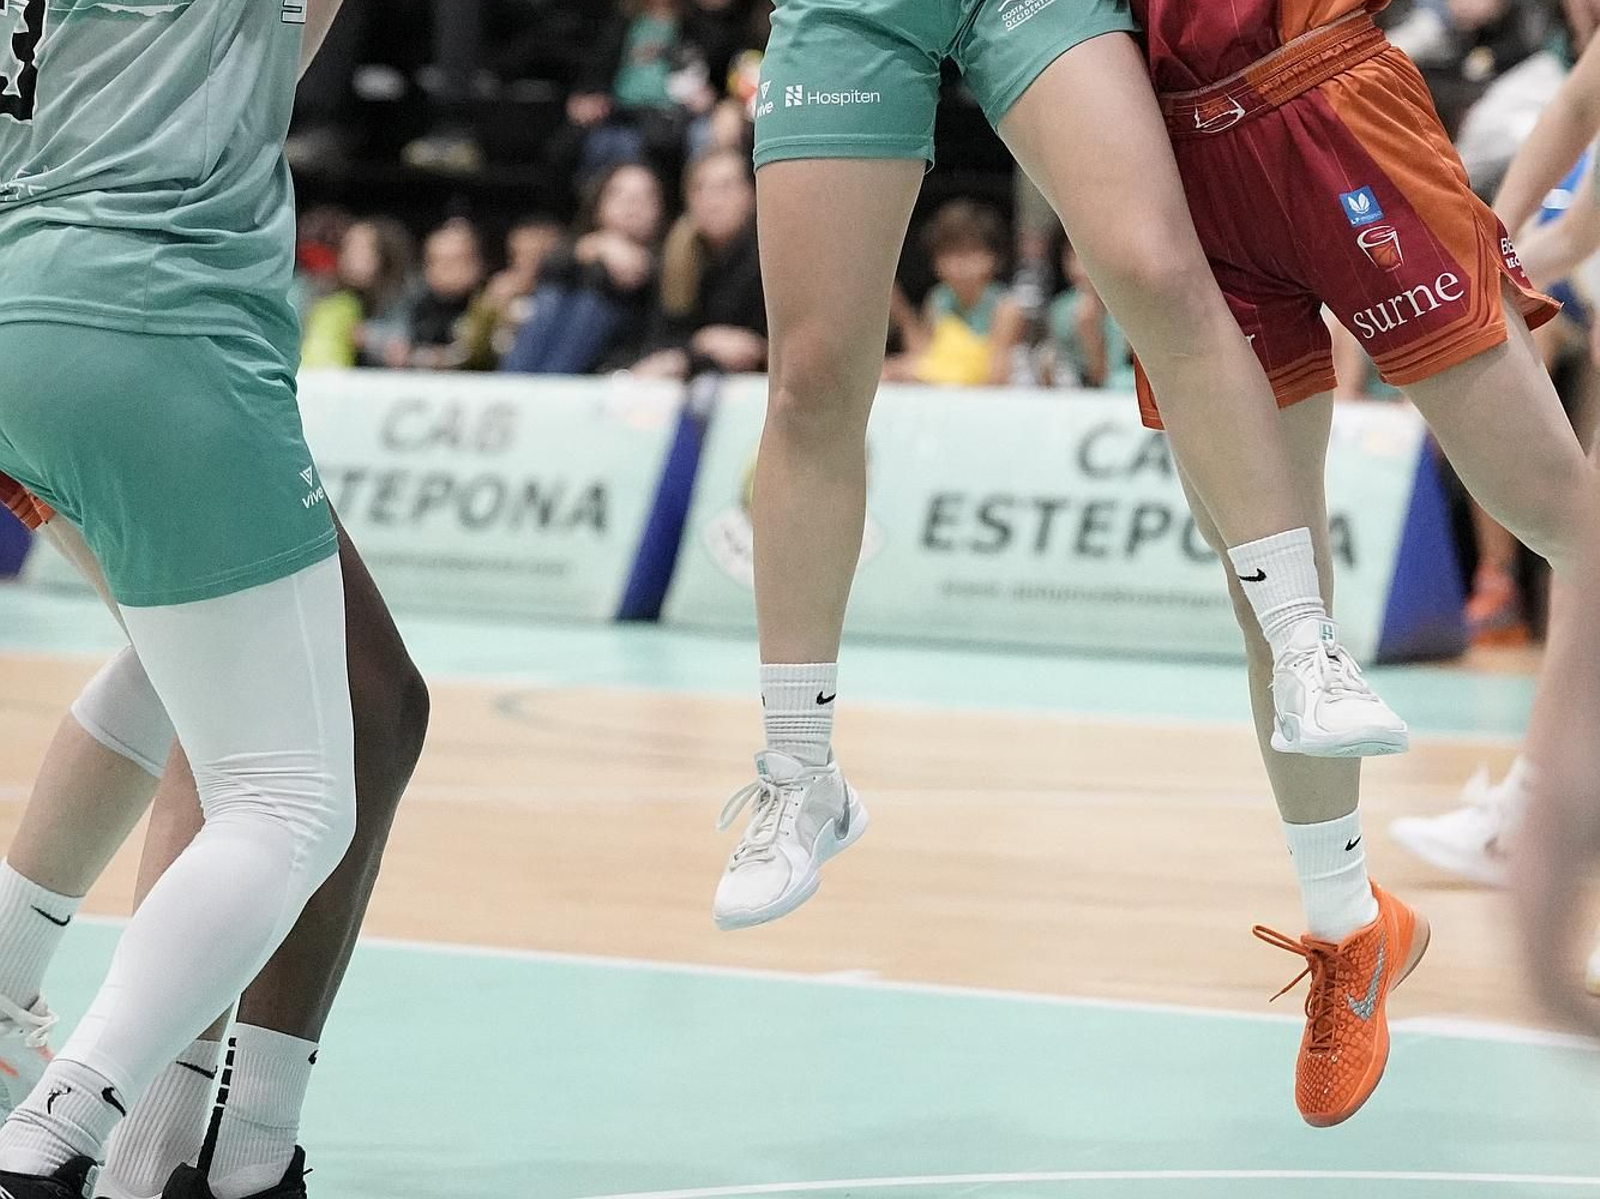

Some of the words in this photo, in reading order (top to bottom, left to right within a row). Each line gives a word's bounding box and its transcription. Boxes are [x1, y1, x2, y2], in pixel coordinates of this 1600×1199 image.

[1002, 6, 1025, 21] COSTA
[807, 89, 881, 107] Hospiten
[1353, 272, 1465, 339] surne
[1074, 420, 1174, 482] CA
[301, 486, 325, 509] vive
[322, 466, 612, 535] TEPONA
[919, 490, 1358, 572] ESTEPOA
